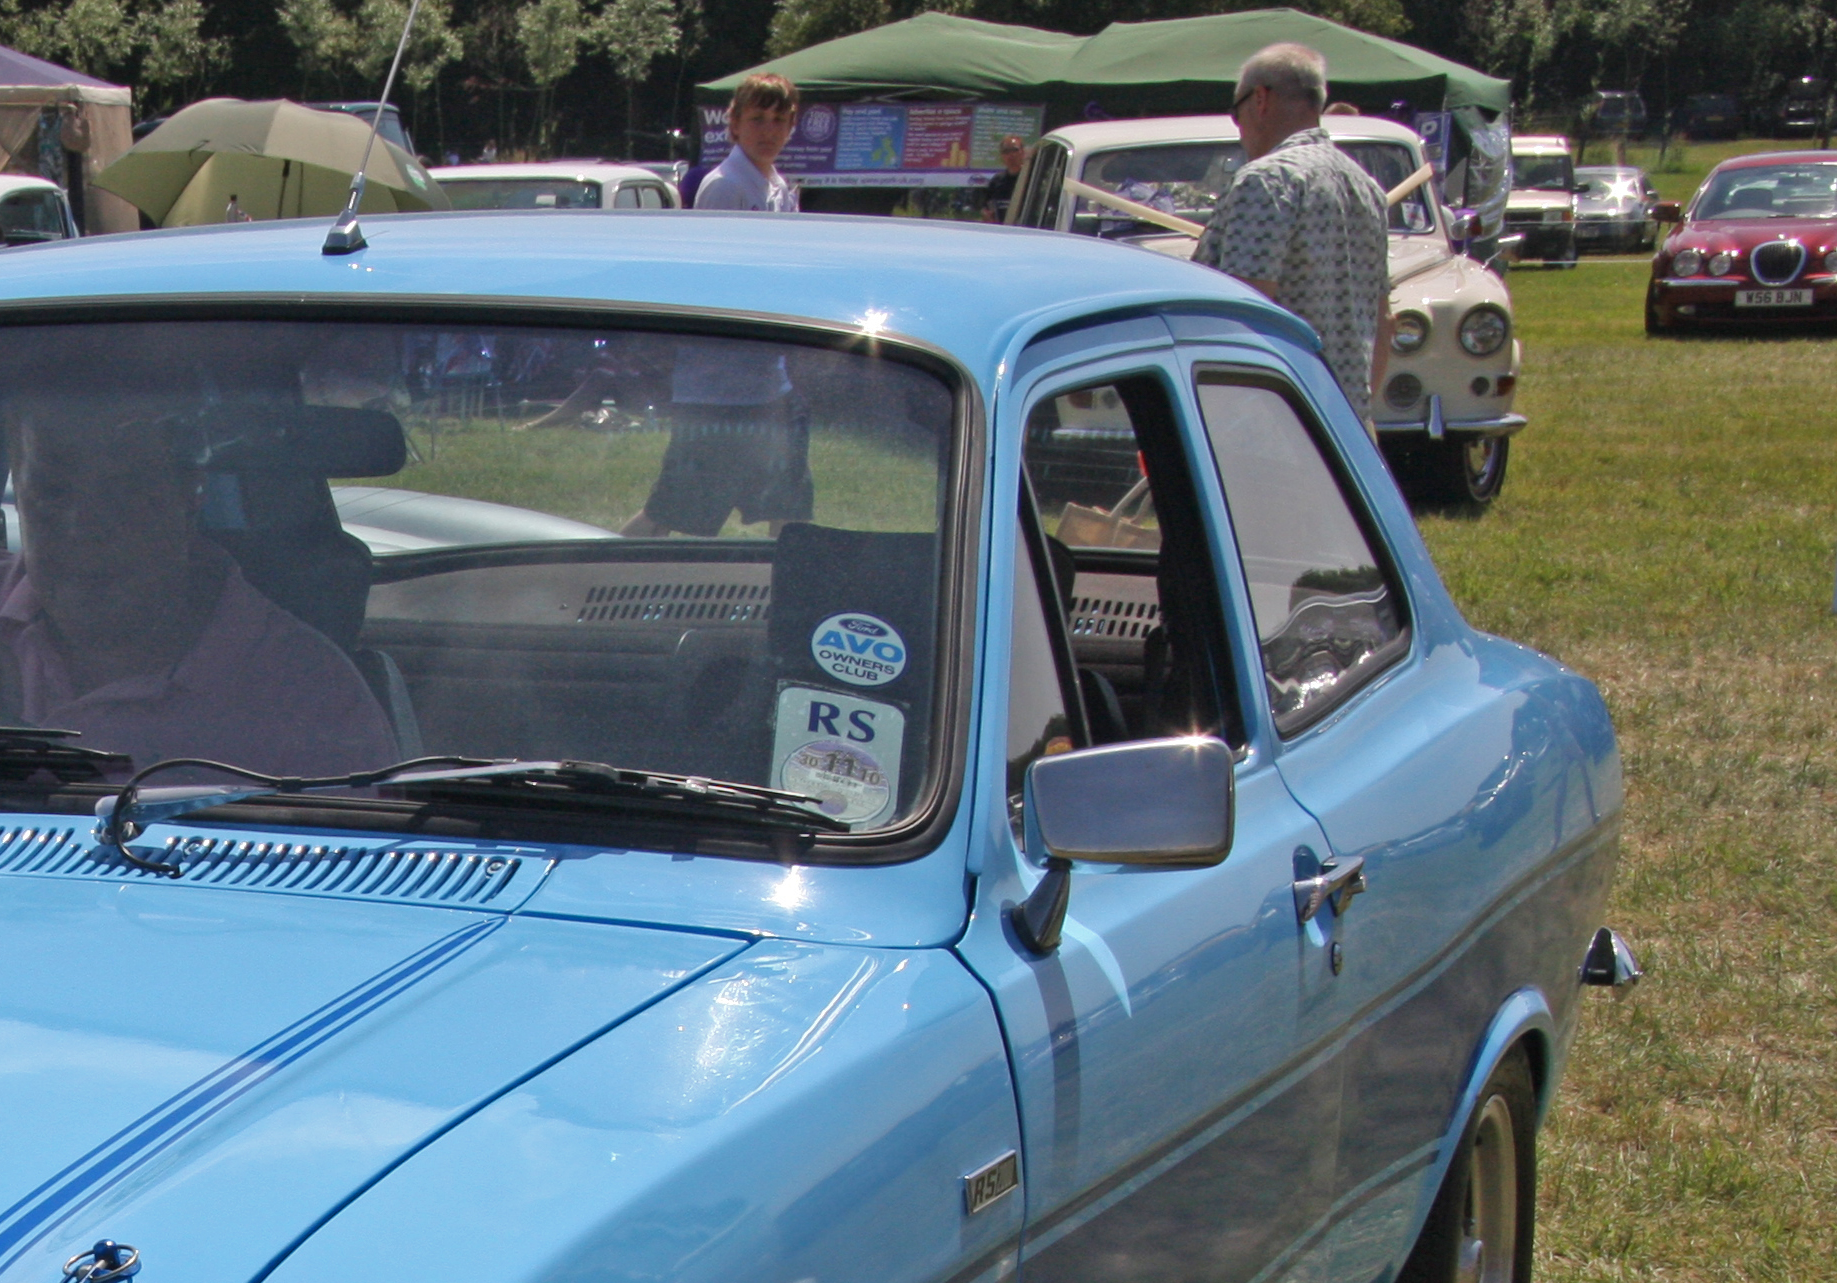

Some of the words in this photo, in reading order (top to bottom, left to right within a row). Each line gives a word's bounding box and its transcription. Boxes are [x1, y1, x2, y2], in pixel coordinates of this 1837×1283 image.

[848, 619, 879, 635] Ford
[816, 629, 904, 663] AVO
[819, 649, 895, 675] OWNERS
[832, 662, 879, 681] CLUB
[807, 700, 876, 743] RS
[860, 767, 881, 785] 10
